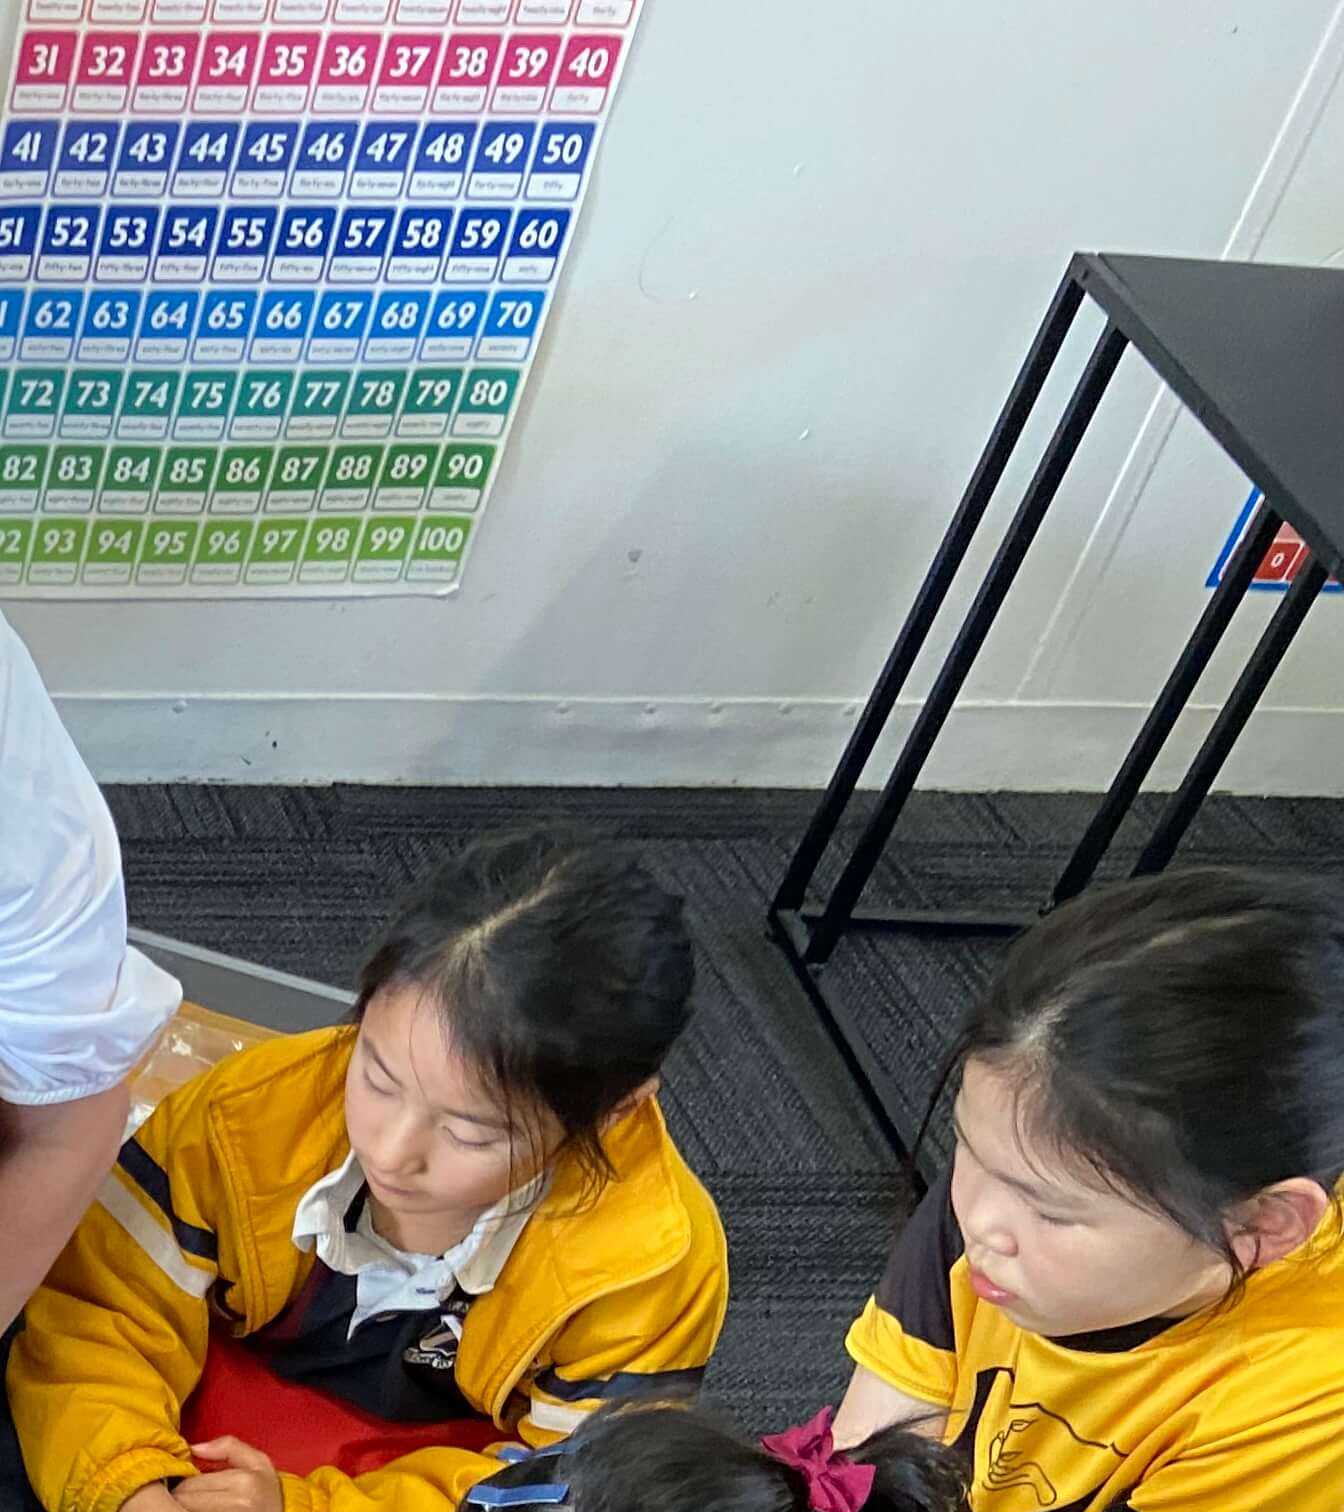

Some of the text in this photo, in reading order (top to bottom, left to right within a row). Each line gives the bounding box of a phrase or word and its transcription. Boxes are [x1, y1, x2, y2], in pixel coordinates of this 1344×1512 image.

[29, 45, 608, 78] 31 32 33 34 35 36 37 38 39 40
[12, 132, 582, 164] 41 42 43 44 45 46 47 48 49 50
[52, 217, 88, 246] 52
[110, 217, 147, 247] 53
[169, 218, 207, 247] 54
[228, 218, 266, 247] 55
[286, 218, 323, 247] 56
[345, 219, 385, 248] 57
[403, 219, 441, 248] 58
[461, 219, 500, 248] 59
[520, 219, 558, 248] 60
[35, 301, 71, 328] 62
[93, 301, 129, 328] 63
[151, 302, 188, 329] 64
[208, 302, 245, 329] 65
[266, 302, 301, 329] 66
[324, 302, 363, 329] 67
[381, 302, 418, 329] 68
[438, 302, 476, 328] 69
[497, 302, 532, 328] 70
[21, 380, 54, 406] 72
[77, 381, 110, 407] 73
[135, 382, 169, 408] 74
[192, 382, 225, 408] 75
[248, 382, 280, 408] 76
[305, 382, 340, 407] 77
[361, 381, 395, 407] 78
[416, 380, 451, 406] 79
[470, 380, 507, 405] 80
[3, 455, 37, 481] 82
[58, 455, 92, 481] 83
[114, 457, 150, 482] 84
[170, 458, 206, 483] 85
[226, 458, 260, 483] 86
[281, 457, 319, 482] 87
[336, 455, 372, 480] 88
[391, 454, 427, 479] 89
[448, 454, 483, 479] 90
[44, 529, 76, 554] 93
[99, 530, 132, 554] 94
[154, 531, 187, 555] 95
[208, 530, 240, 555] 96
[263, 529, 297, 554] 97
[317, 528, 350, 552] 98
[371, 527, 404, 552] 99
[419, 527, 463, 552] 100
